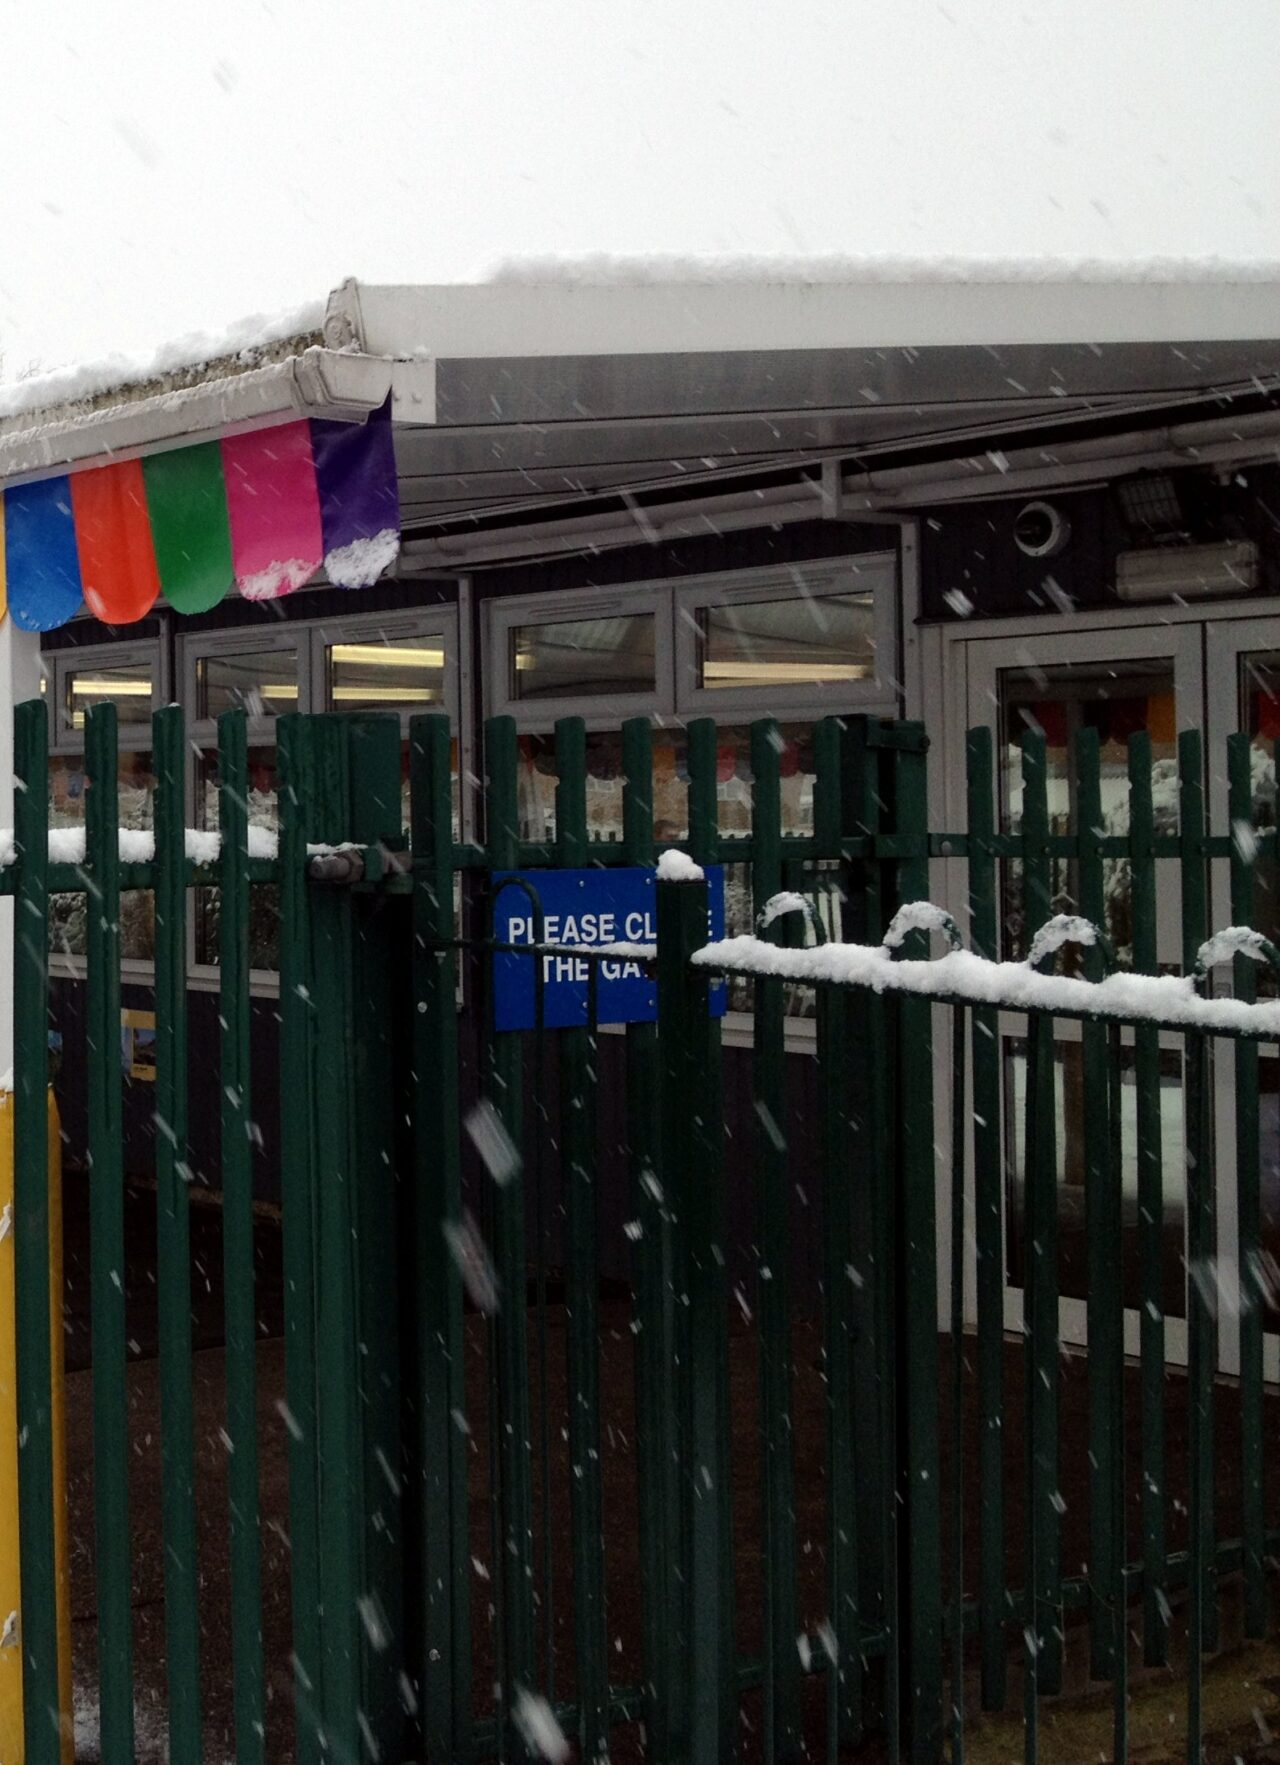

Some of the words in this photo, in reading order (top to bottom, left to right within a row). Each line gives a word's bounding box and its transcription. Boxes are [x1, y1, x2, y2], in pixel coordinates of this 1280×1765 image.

[508, 914, 615, 944] PLEASE
[543, 955, 589, 983] THE
[601, 960, 648, 981] GA
